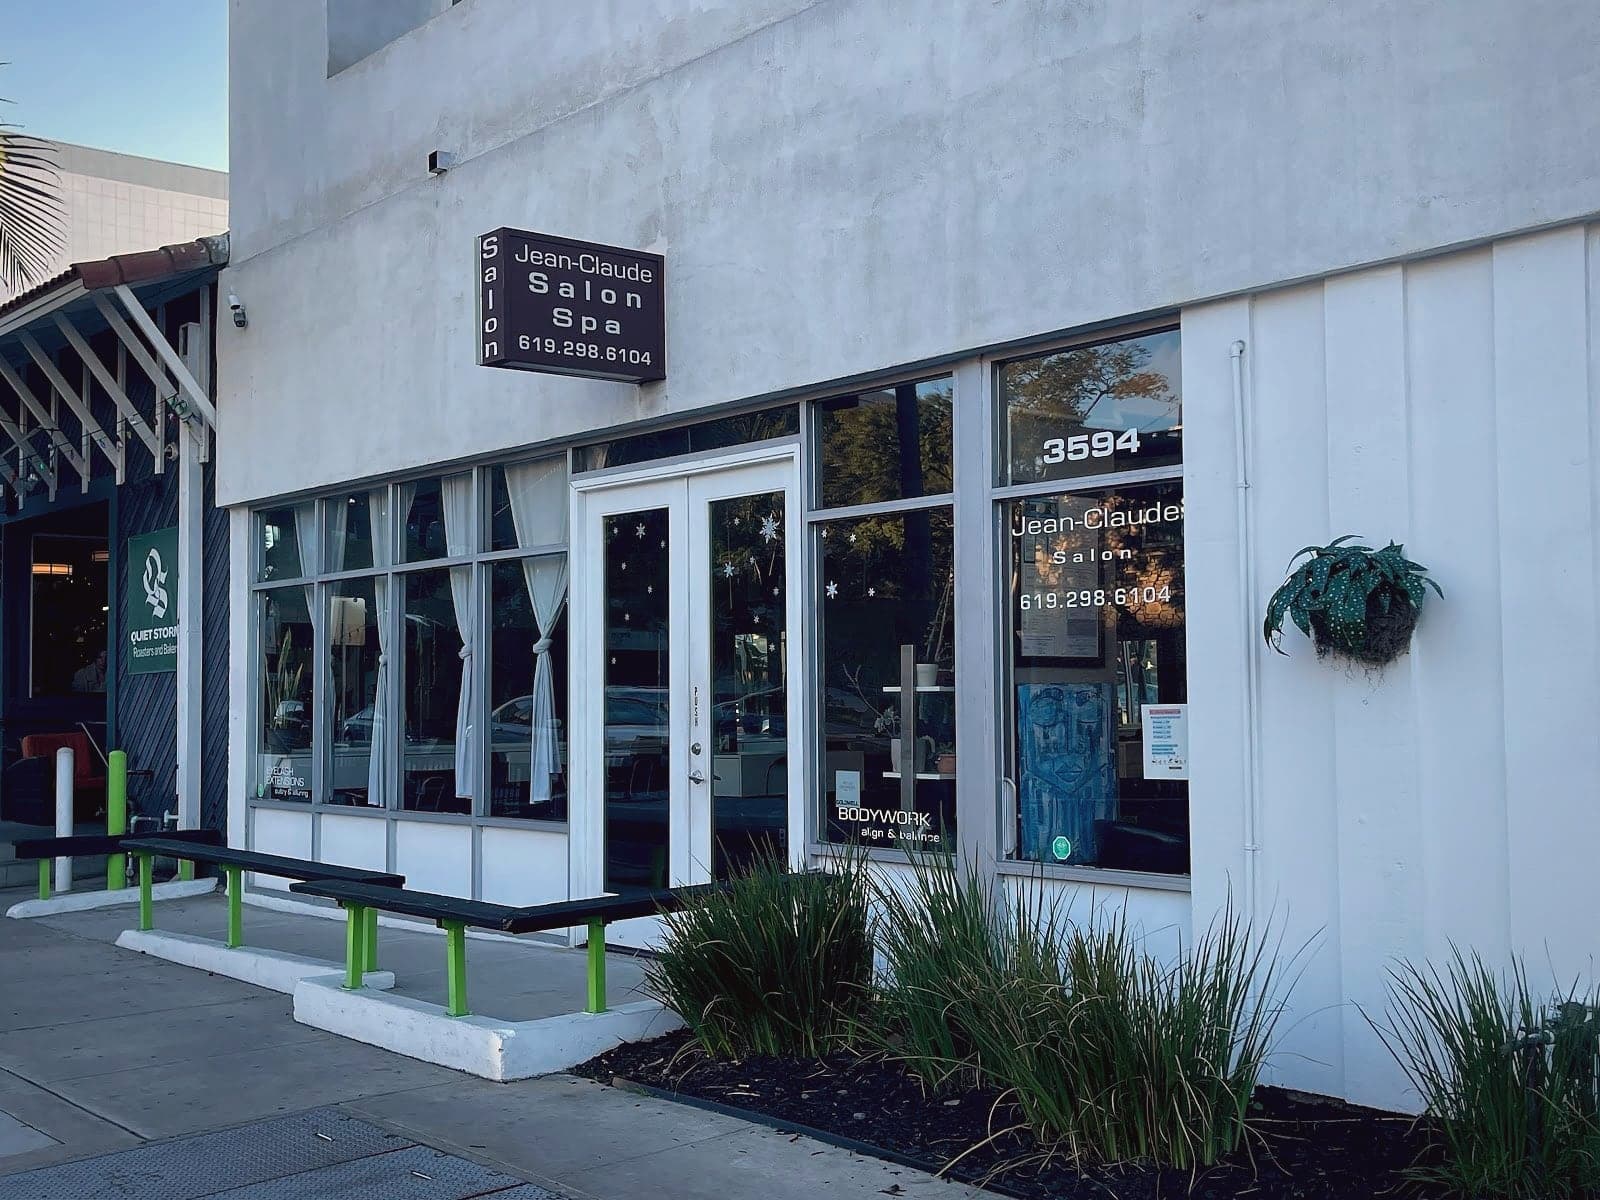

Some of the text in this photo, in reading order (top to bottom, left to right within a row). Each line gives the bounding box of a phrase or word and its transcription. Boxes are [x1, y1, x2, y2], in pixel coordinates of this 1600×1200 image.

[515, 244, 653, 283] Jean-Claude
[482, 236, 498, 358] Salon
[528, 272, 642, 309] Salon
[552, 307, 621, 335] Spa
[518, 335, 651, 365] 619.298.6104
[1043, 428, 1141, 464] 3594
[1012, 502, 1180, 537] Jean-Claude
[1053, 549, 1132, 564] Salon
[1020, 585, 1171, 610] 619.298.6104
[131, 629, 153, 645] QUIET
[838, 807, 930, 827] BODYWORK
[887, 828, 897, 839] &
